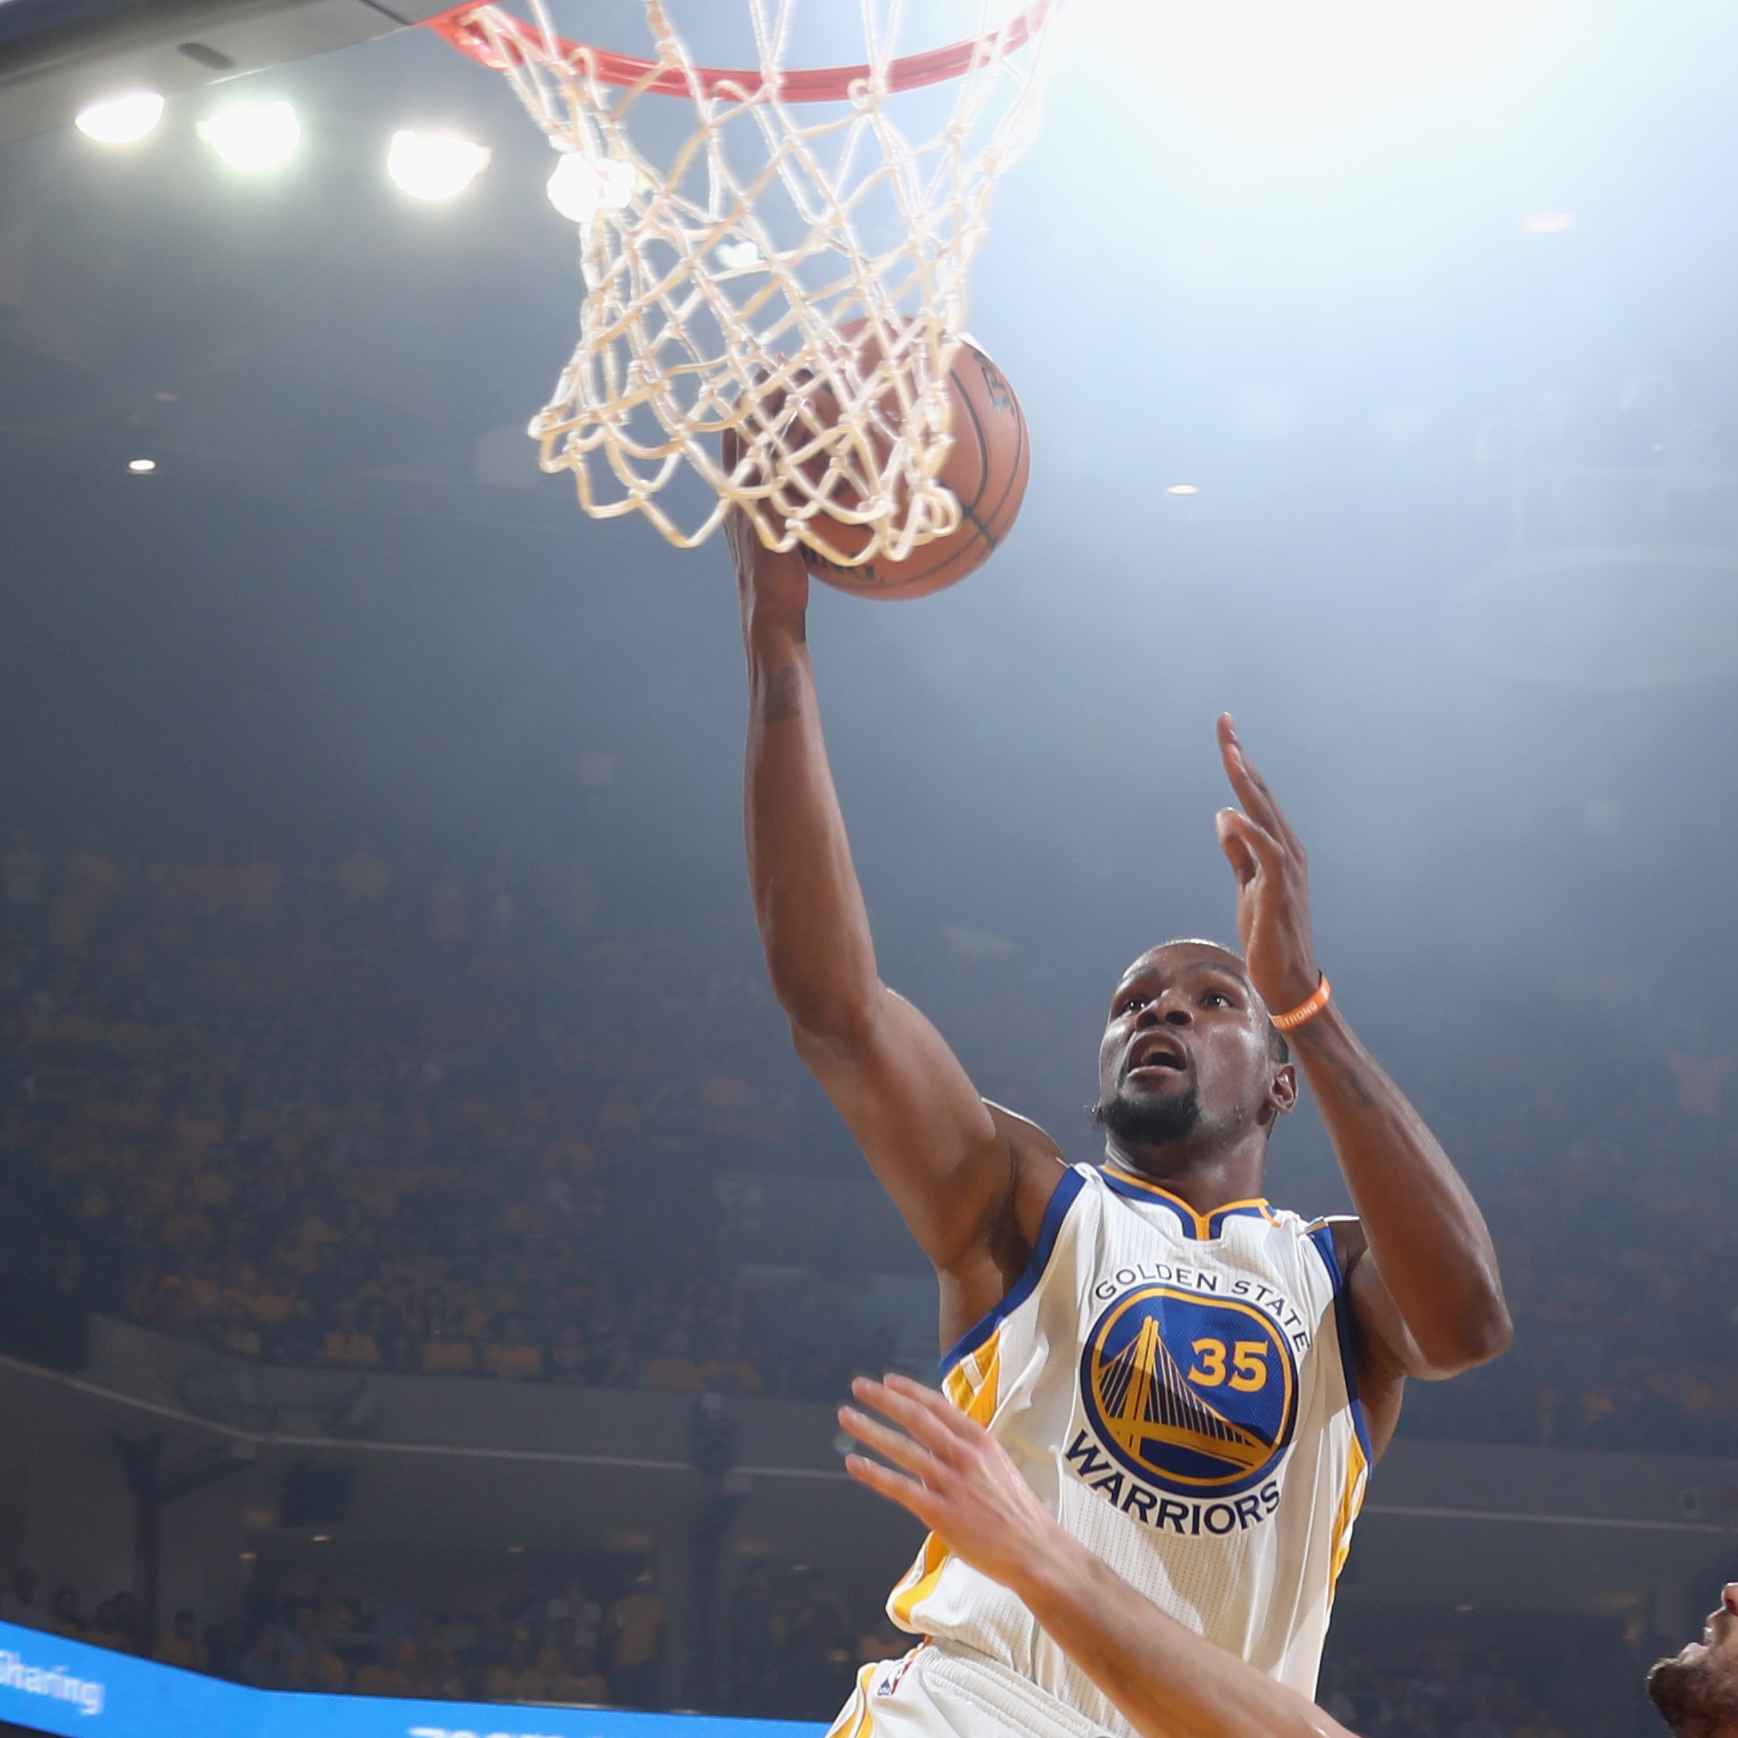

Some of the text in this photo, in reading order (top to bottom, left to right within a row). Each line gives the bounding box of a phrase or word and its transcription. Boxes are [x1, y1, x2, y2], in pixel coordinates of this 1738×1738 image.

[1094, 1262, 1312, 1353] GOLDEN STATE
[1188, 1338, 1270, 1393] 35
[1063, 1427, 1283, 1537] WARRIORS
